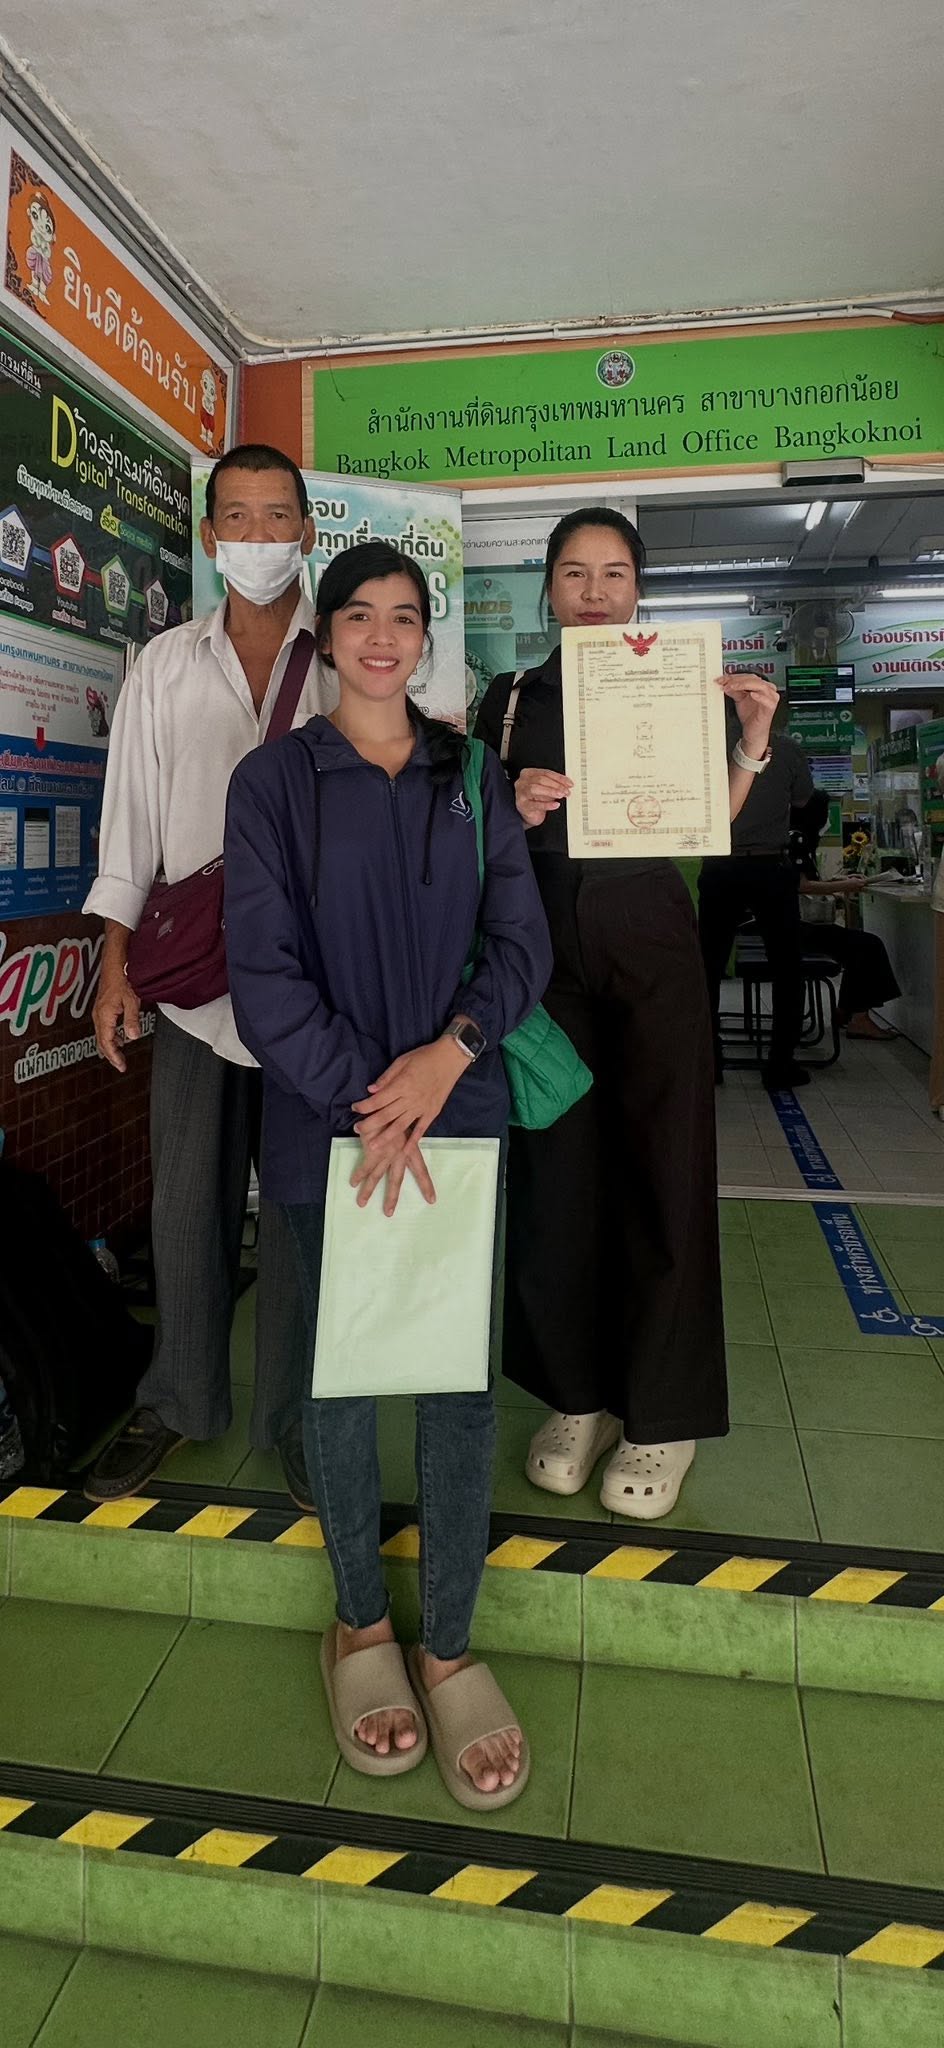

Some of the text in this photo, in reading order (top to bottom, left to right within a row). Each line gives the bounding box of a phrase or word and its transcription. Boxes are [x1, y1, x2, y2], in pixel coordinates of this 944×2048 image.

[63, 246, 197, 416] ยินดีต้อนรับ
[367, 373, 900, 434] สำนักงานที่ดินกรุงเทพมหานคร สาขาบางกอกน้อย
[336, 418, 924, 480] Bangkok Metropolitan Land Office Bangkoknoi
[115, 476, 189, 538] Transformation
[0, 932, 105, 1036] appy
